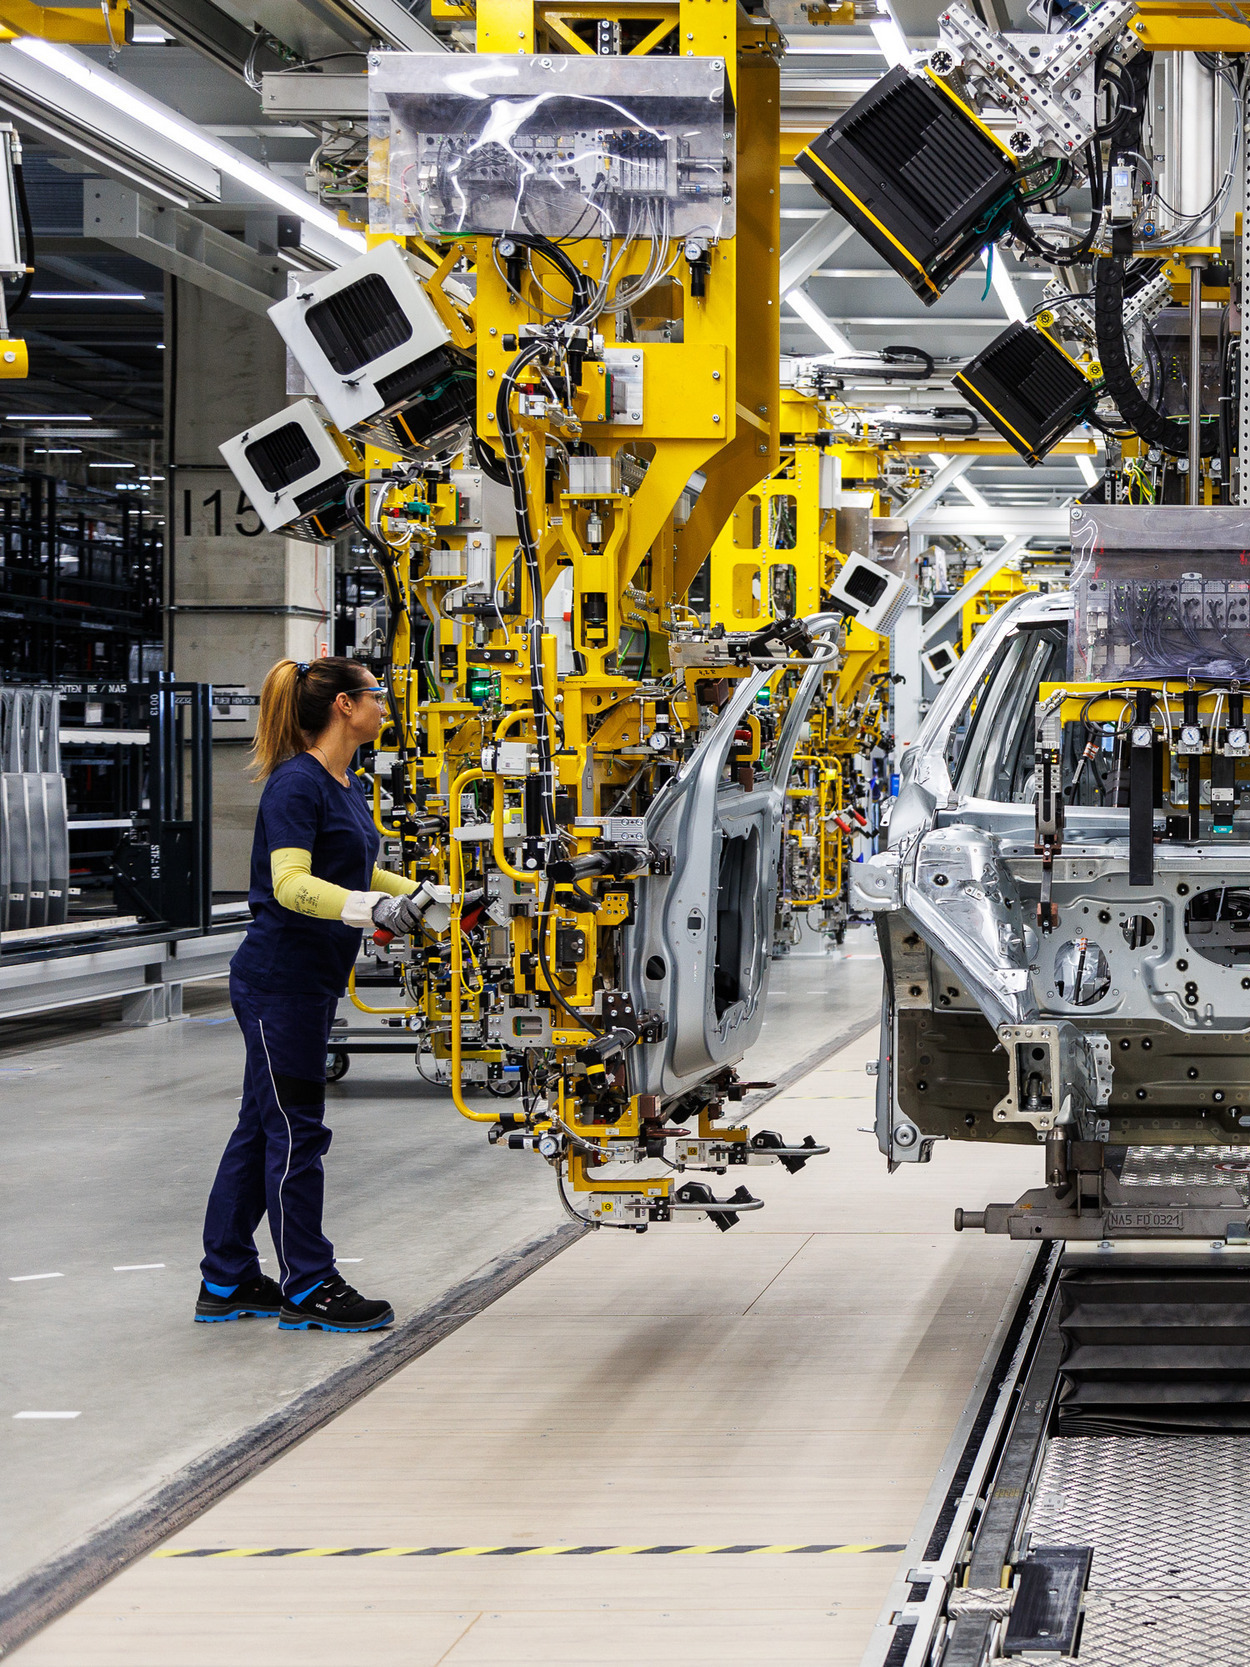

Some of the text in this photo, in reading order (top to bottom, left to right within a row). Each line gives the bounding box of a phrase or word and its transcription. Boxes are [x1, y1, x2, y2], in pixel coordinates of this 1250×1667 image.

[184, 490, 265, 537] I15
[150, 694, 159, 716] 0013
[1136, 1214, 1151, 1225] FD
[1153, 1214, 1179, 1225] 0321
